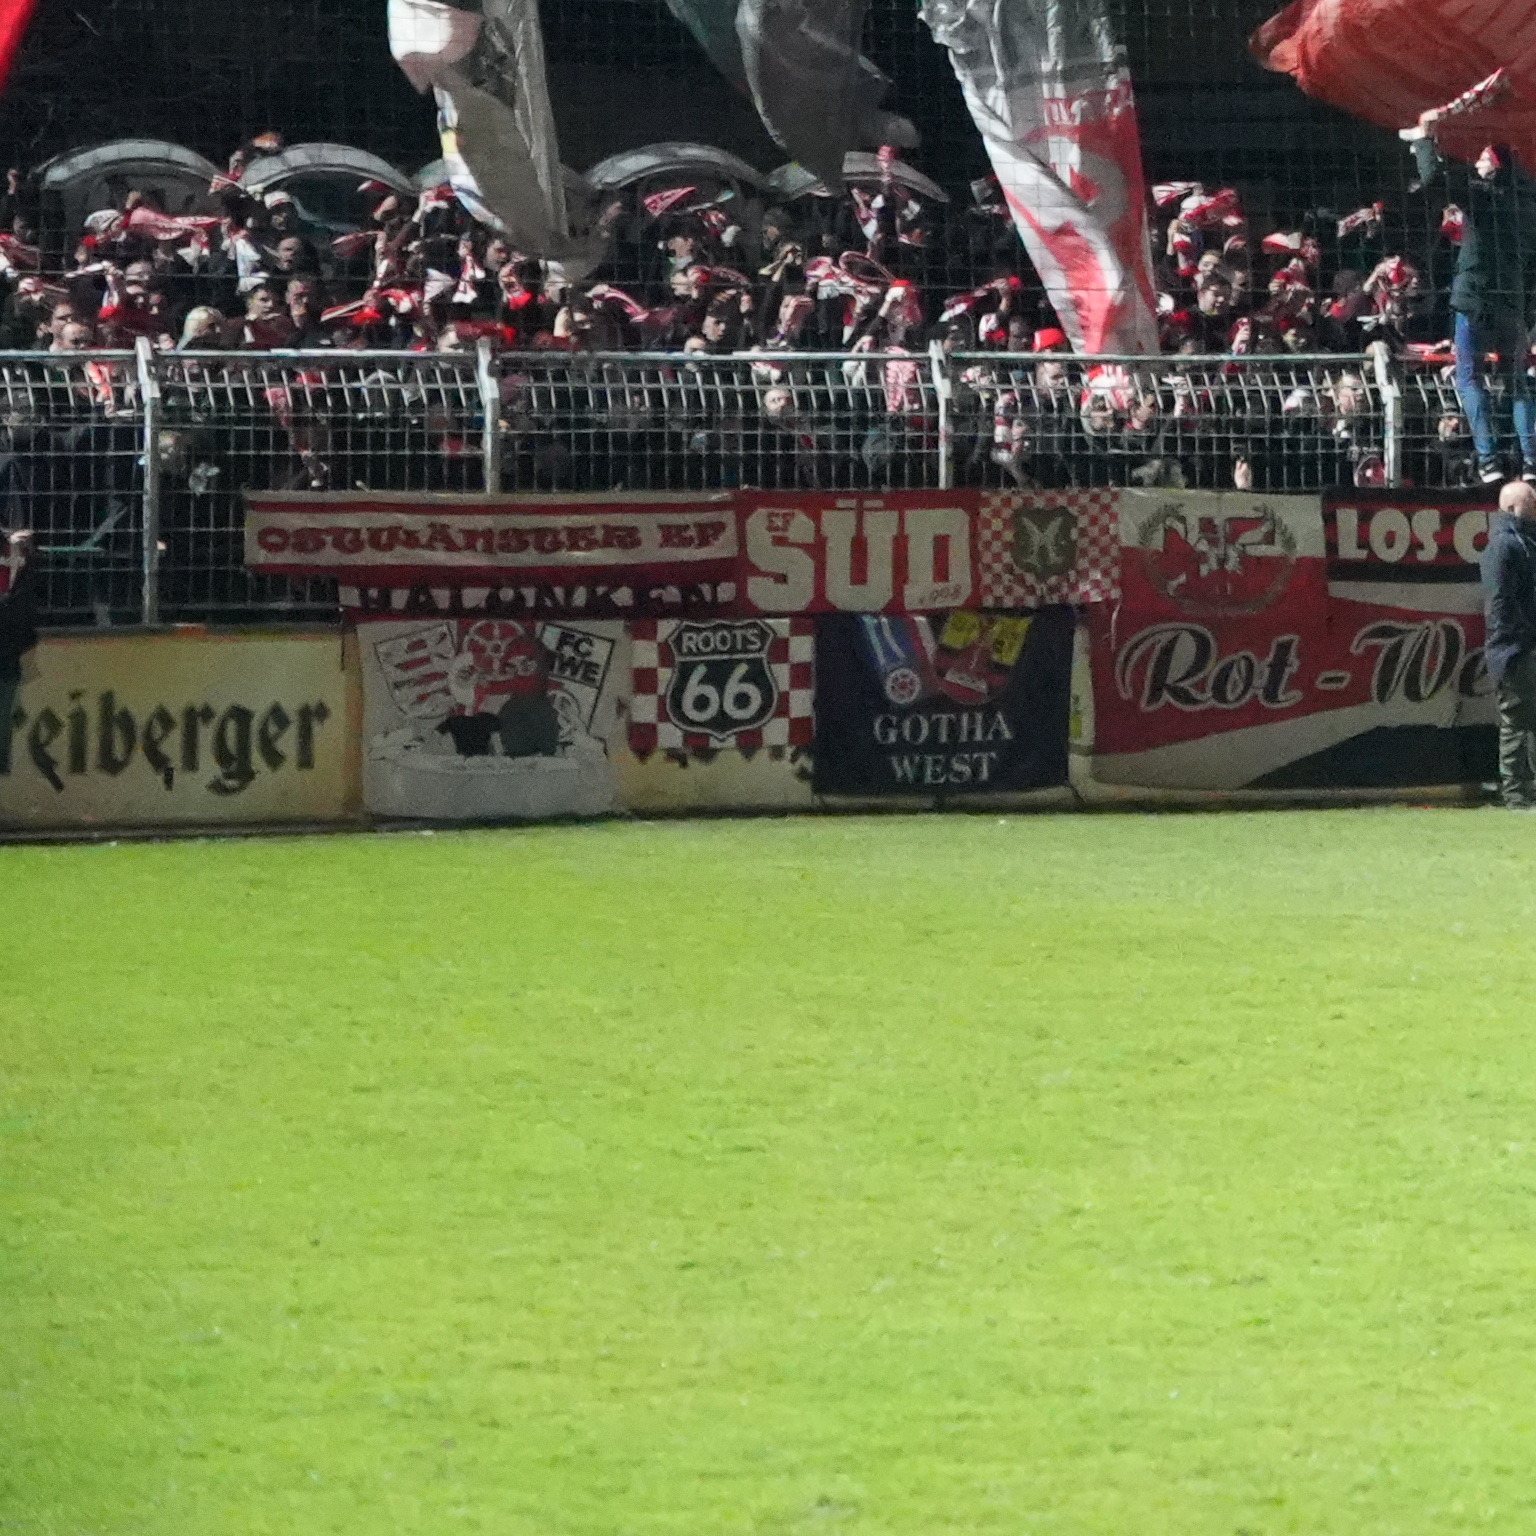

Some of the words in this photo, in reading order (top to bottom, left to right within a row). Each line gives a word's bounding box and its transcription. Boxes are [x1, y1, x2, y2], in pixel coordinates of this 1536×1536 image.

[1336, 508, 1441, 562] LOS
[746, 498, 978, 613] SÜD
[559, 630, 593, 658] FC
[682, 628, 761, 655] ROOTS
[549, 652, 600, 684] WE
[681, 663, 763, 723] 66
[873, 709, 1015, 746] GOTHA
[890, 752, 995, 787] WEST
